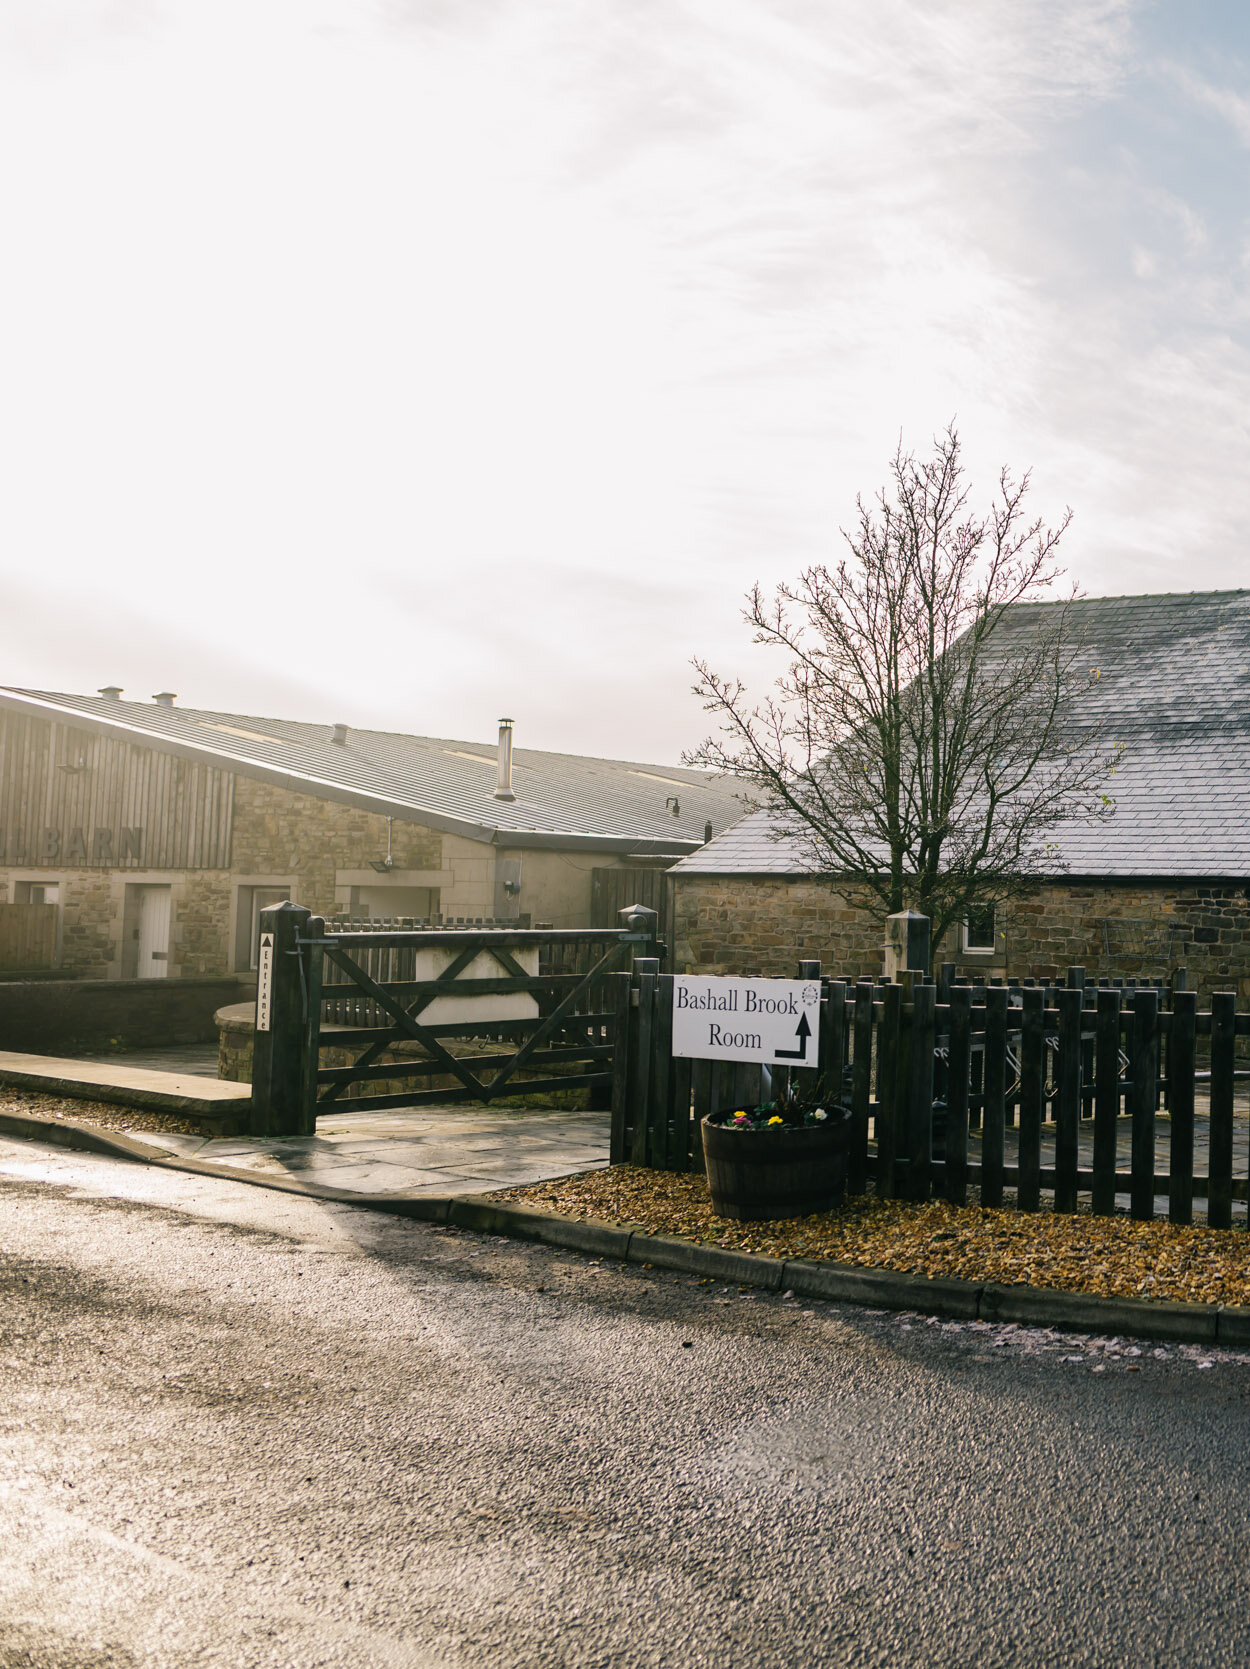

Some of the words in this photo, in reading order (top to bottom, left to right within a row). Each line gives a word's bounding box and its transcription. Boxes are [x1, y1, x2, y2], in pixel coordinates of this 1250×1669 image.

[41, 827, 142, 859] BARN
[261, 950, 269, 1030] Entrance
[677, 986, 738, 1012] Bashall
[743, 989, 799, 1015] Brook
[708, 1023, 762, 1049] Room
